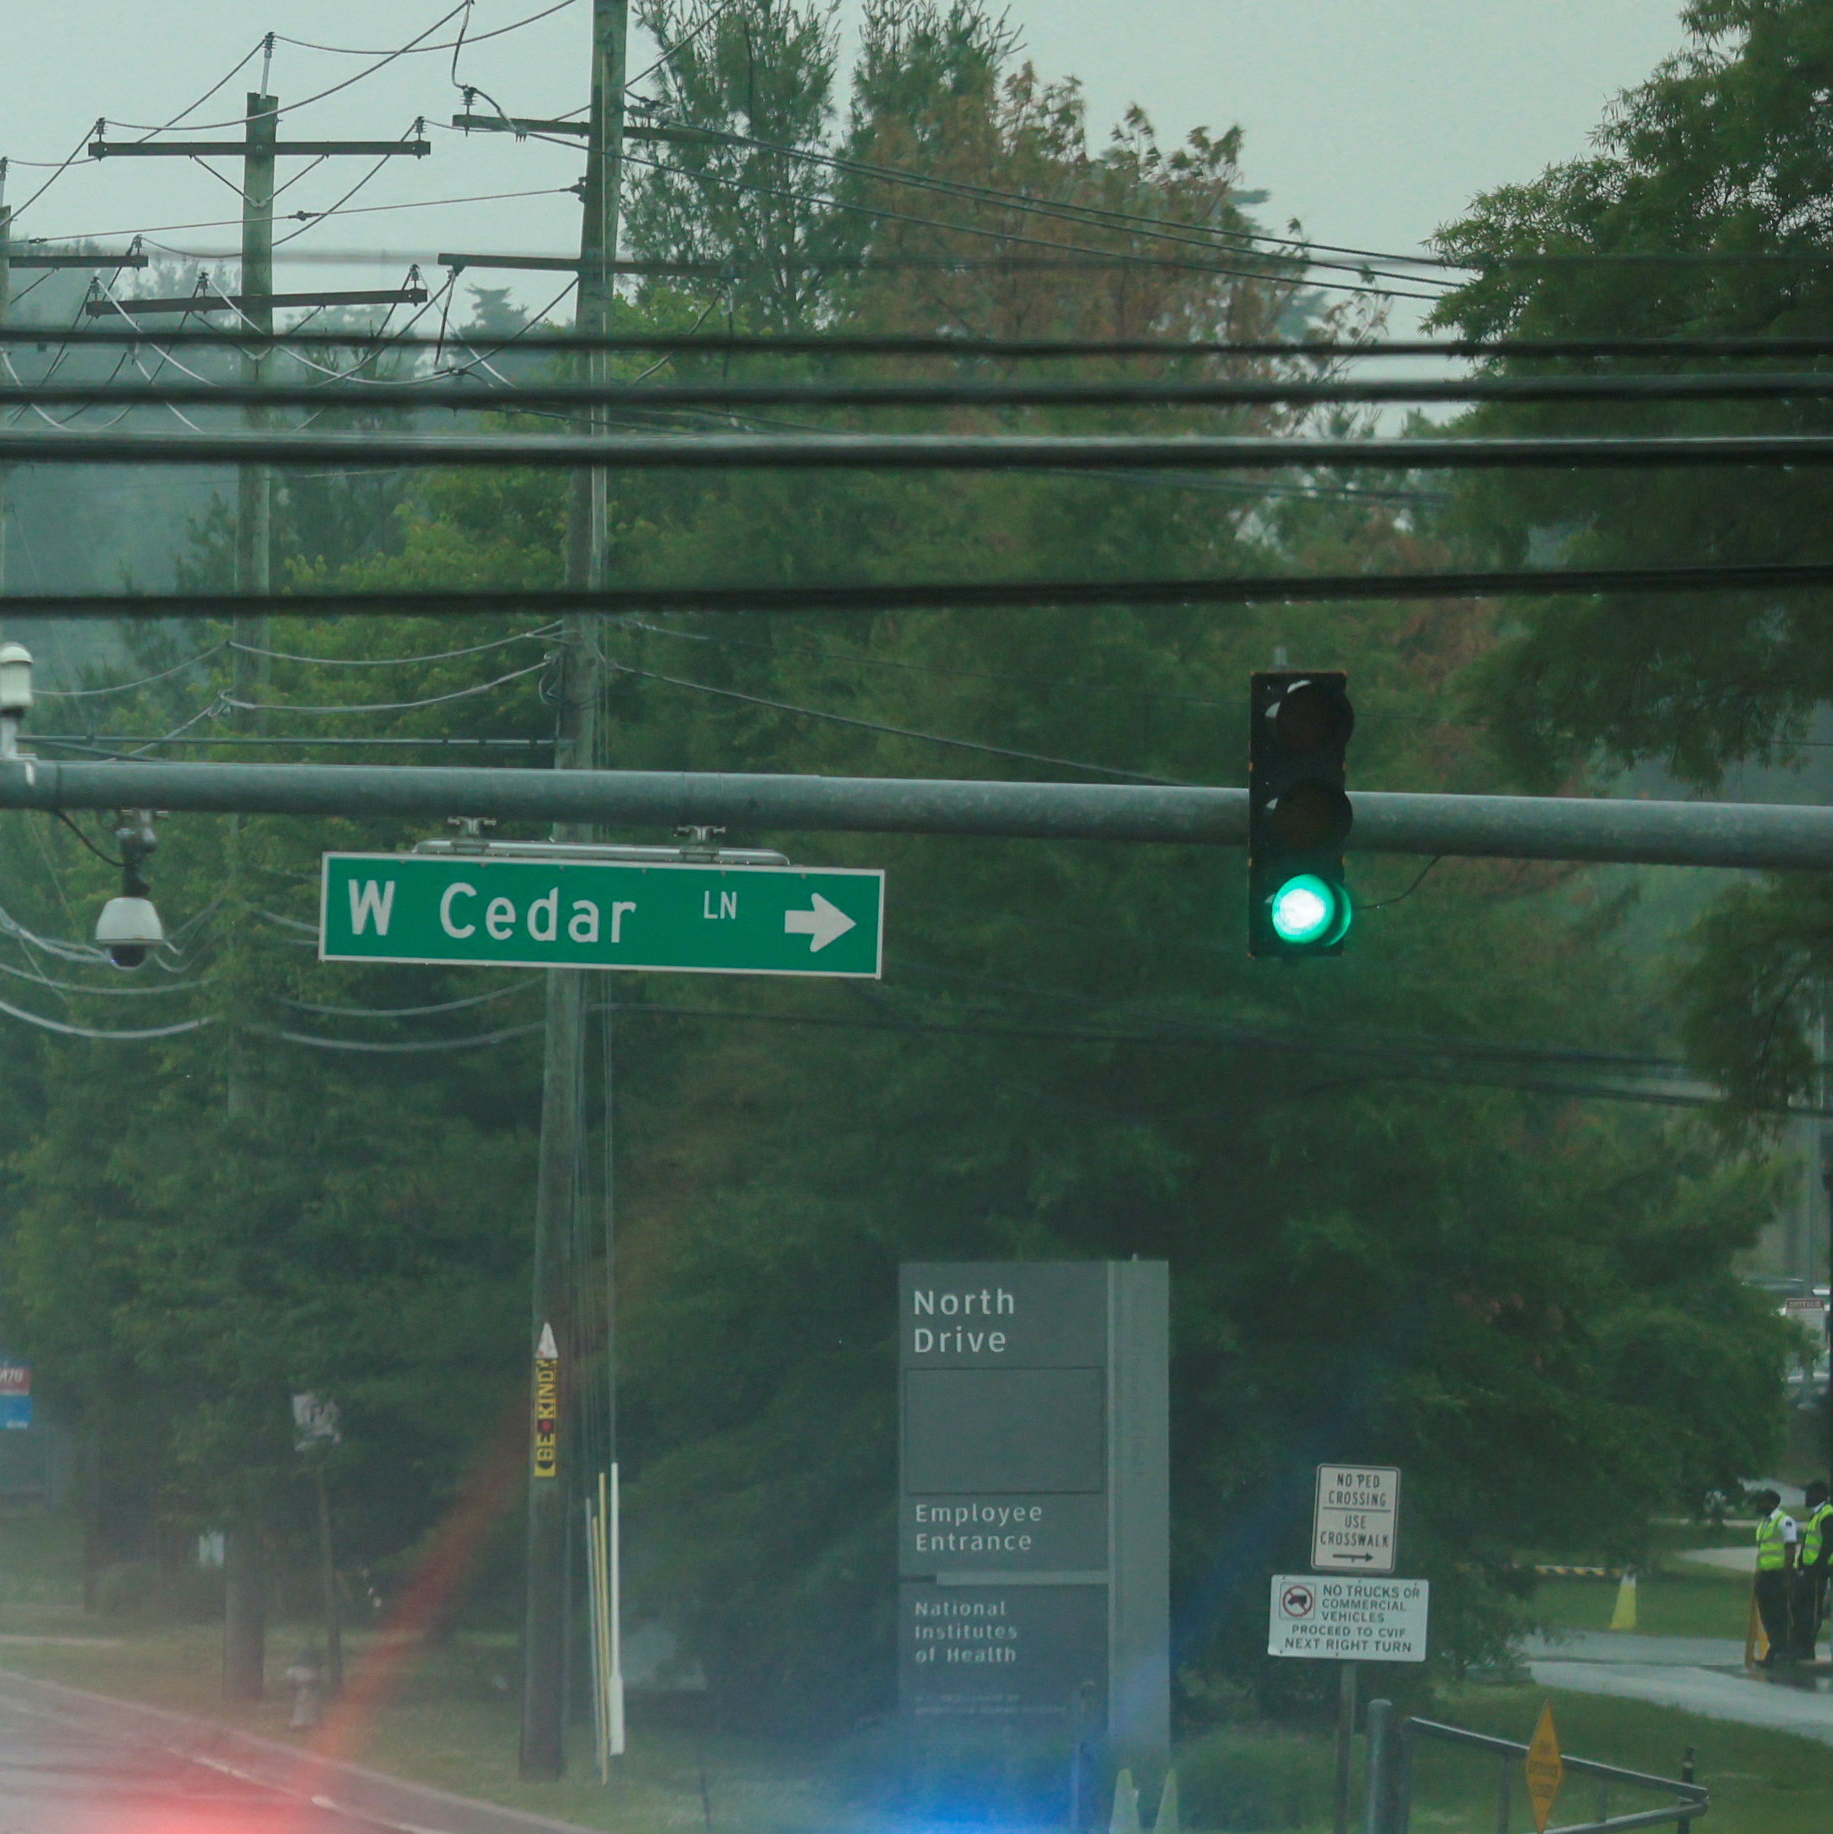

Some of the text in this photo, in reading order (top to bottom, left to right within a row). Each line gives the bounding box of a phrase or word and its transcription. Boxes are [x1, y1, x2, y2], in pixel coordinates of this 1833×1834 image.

[347, 878, 738, 944] W Cedar LN
[914, 1288, 1015, 1316] North
[914, 1326, 1007, 1353] Drive
[537, 1370, 556, 1462] BE KIND
[1336, 1472, 1380, 1489] NO PED
[1328, 1490, 1387, 1507] CROSSING
[915, 1503, 1043, 1526] Employee
[1344, 1514, 1367, 1529] USE
[915, 1533, 1032, 1551] Entrance
[1320, 1531, 1389, 1548] CROSSWALK
[1323, 1584, 1421, 1599] NO TRUCKS OR
[915, 1601, 1007, 1616] National
[1321, 1599, 1406, 1612] COMMERCIAL
[1321, 1611, 1386, 1623] VEHICLES
[915, 1623, 1018, 1640] Institutes
[1291, 1624, 1352, 1636] PROCEED
[1357, 1626, 1374, 1638] TO
[1284, 1638, 1413, 1653] NEXT RIGHT TURN
[915, 1646, 1017, 1663] of Health
